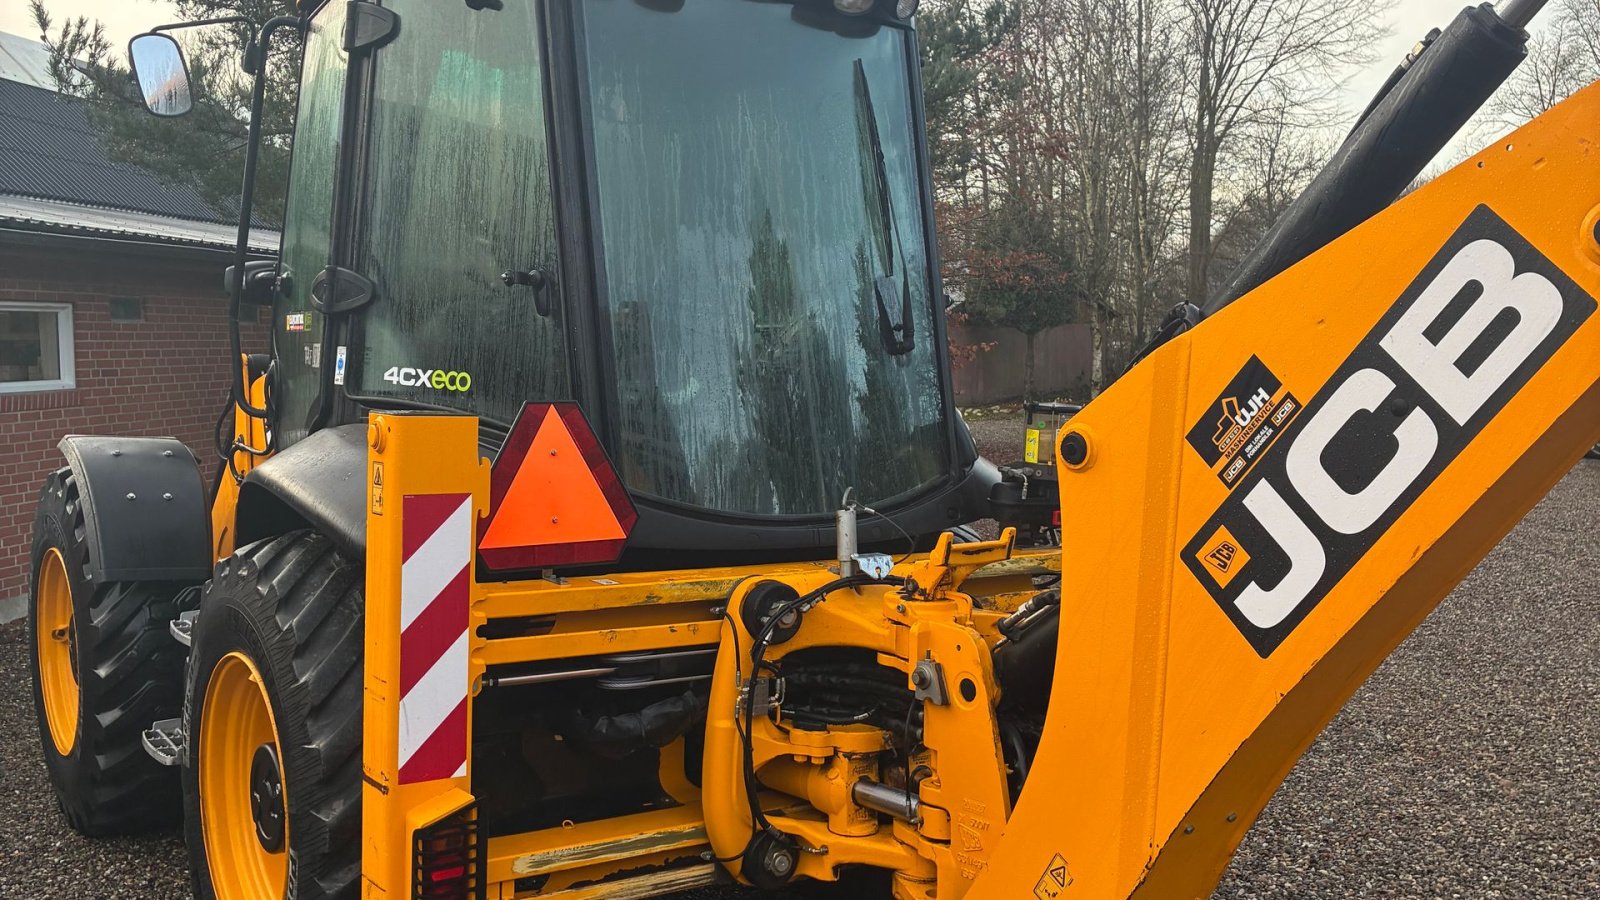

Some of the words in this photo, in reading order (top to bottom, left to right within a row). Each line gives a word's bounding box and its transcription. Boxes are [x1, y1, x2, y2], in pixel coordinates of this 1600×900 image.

[383, 366, 472, 392] 4CXeco
[1234, 387, 1270, 427] UJH
[1275, 402, 1293, 423] JCB
[1224, 400, 1275, 459] MASKINSERVICE
[1233, 238, 1563, 629] JCB
[1253, 425, 1269, 443] LOKALE
[1226, 459, 1244, 479] JCB
[1209, 543, 1235, 569] JCB
